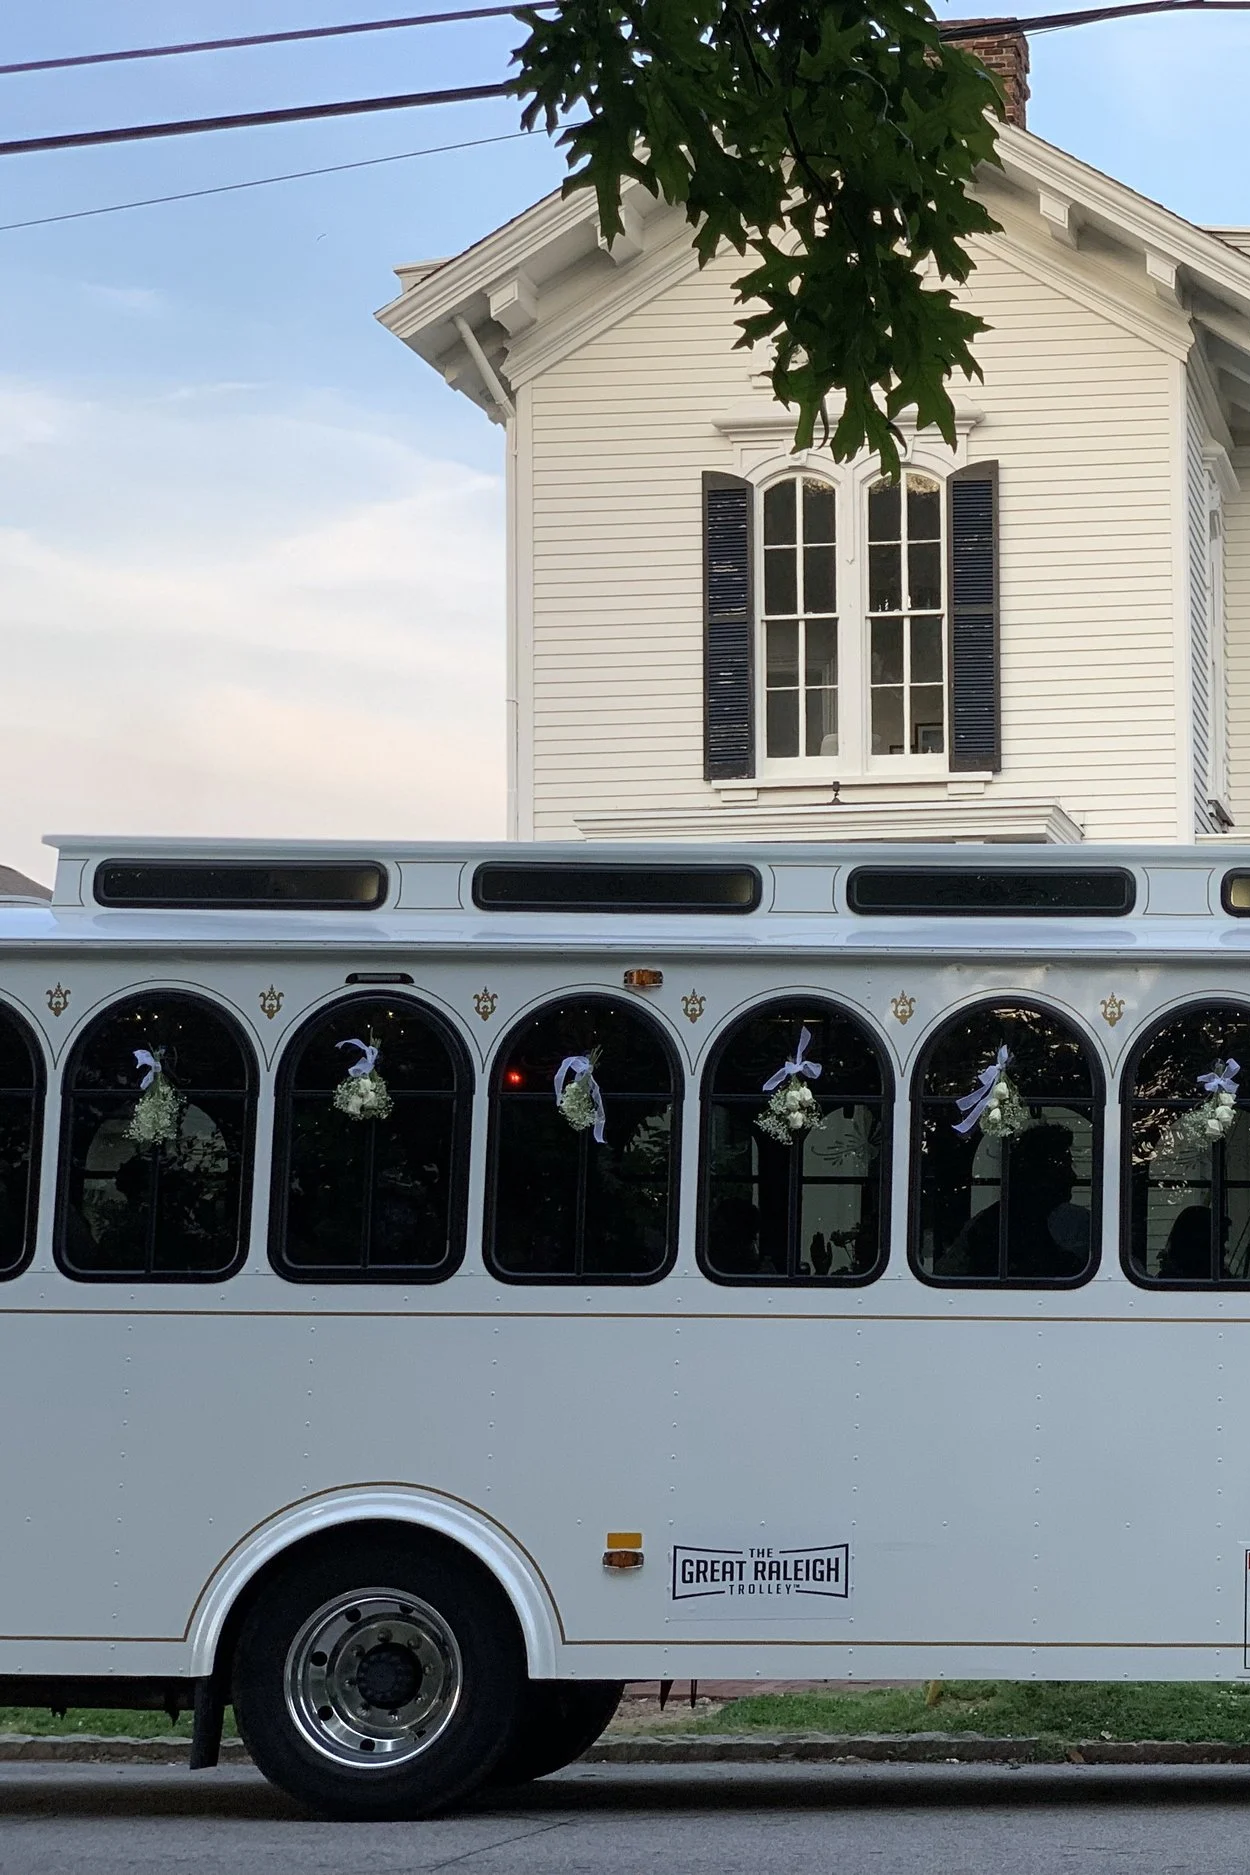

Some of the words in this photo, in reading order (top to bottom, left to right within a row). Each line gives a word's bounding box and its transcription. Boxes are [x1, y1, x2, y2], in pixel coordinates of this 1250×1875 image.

[749, 1548, 773, 1558] THE
[681, 1559, 747, 1583] GREAT
[754, 1557, 839, 1582] RALEIGH
